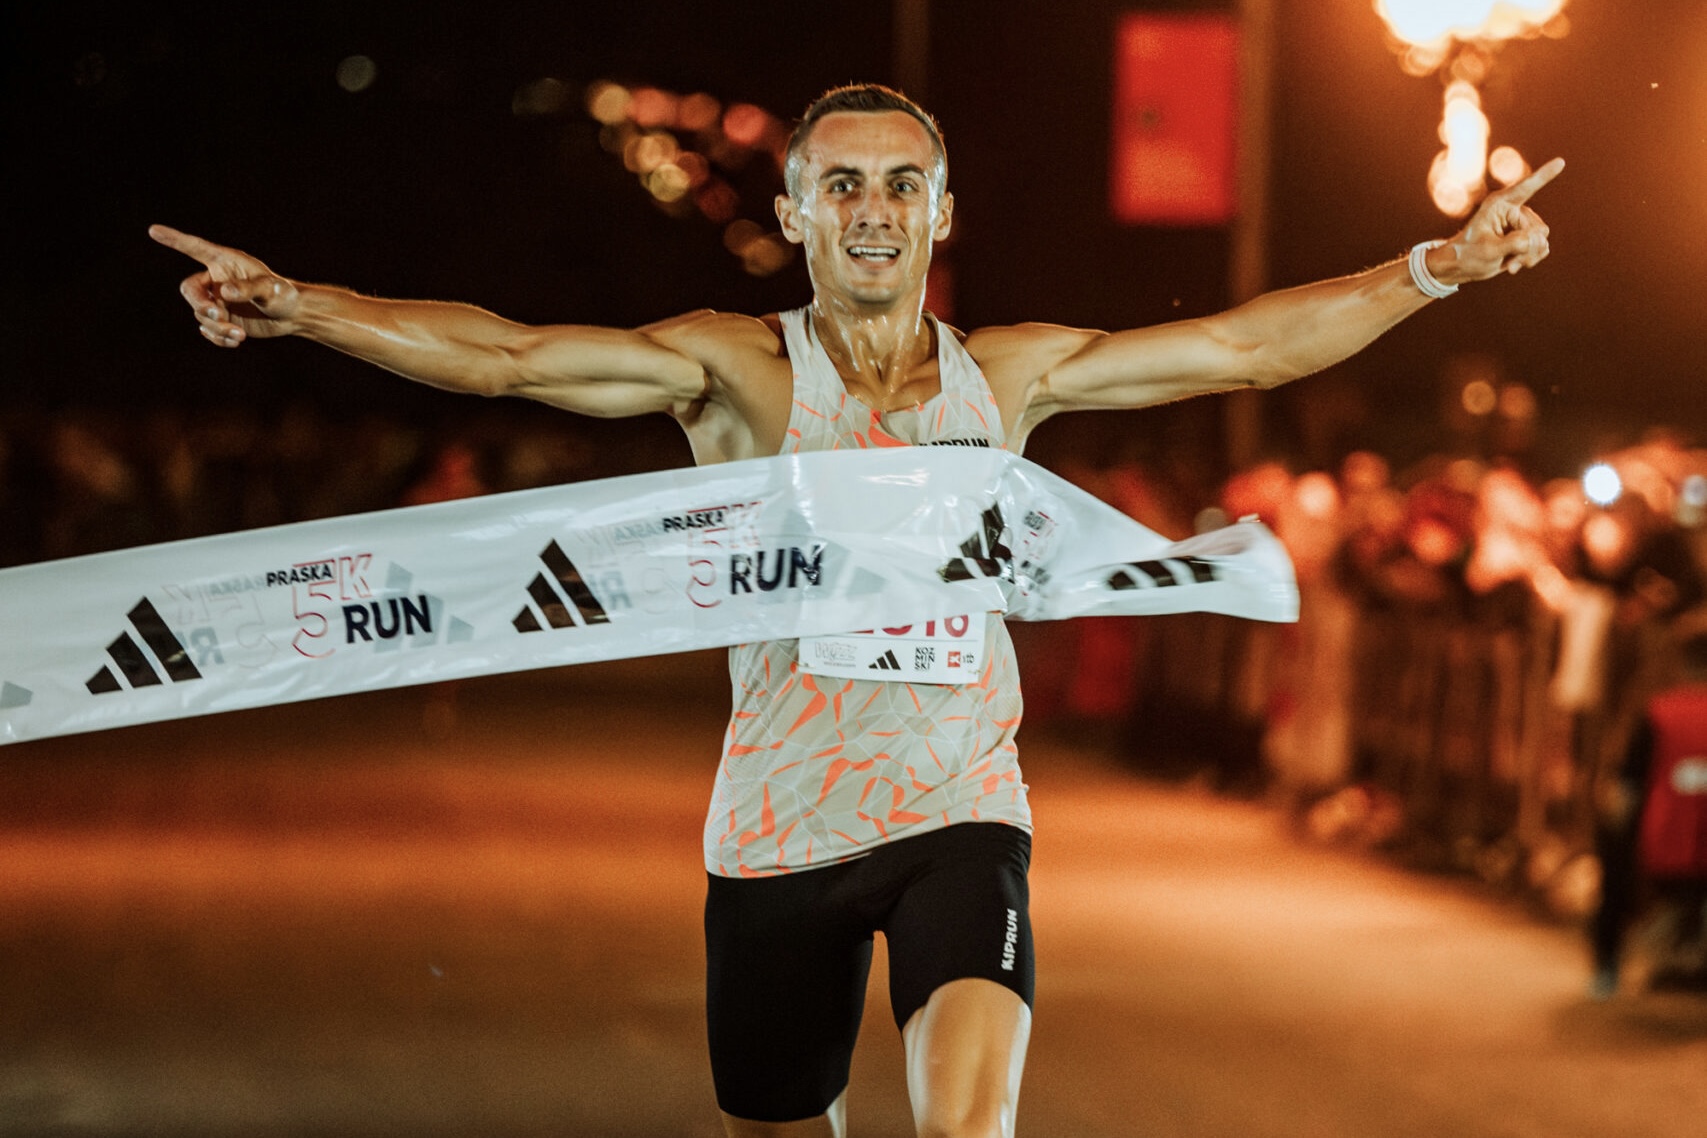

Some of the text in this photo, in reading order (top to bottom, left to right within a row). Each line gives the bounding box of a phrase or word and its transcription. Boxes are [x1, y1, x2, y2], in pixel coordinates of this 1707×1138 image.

[266, 563, 333, 588] PRASKA
[730, 544, 824, 595] RUN
[291, 553, 373, 659] 5K
[342, 594, 433, 645] RUN
[1000, 907, 1018, 971] KIPRUN
